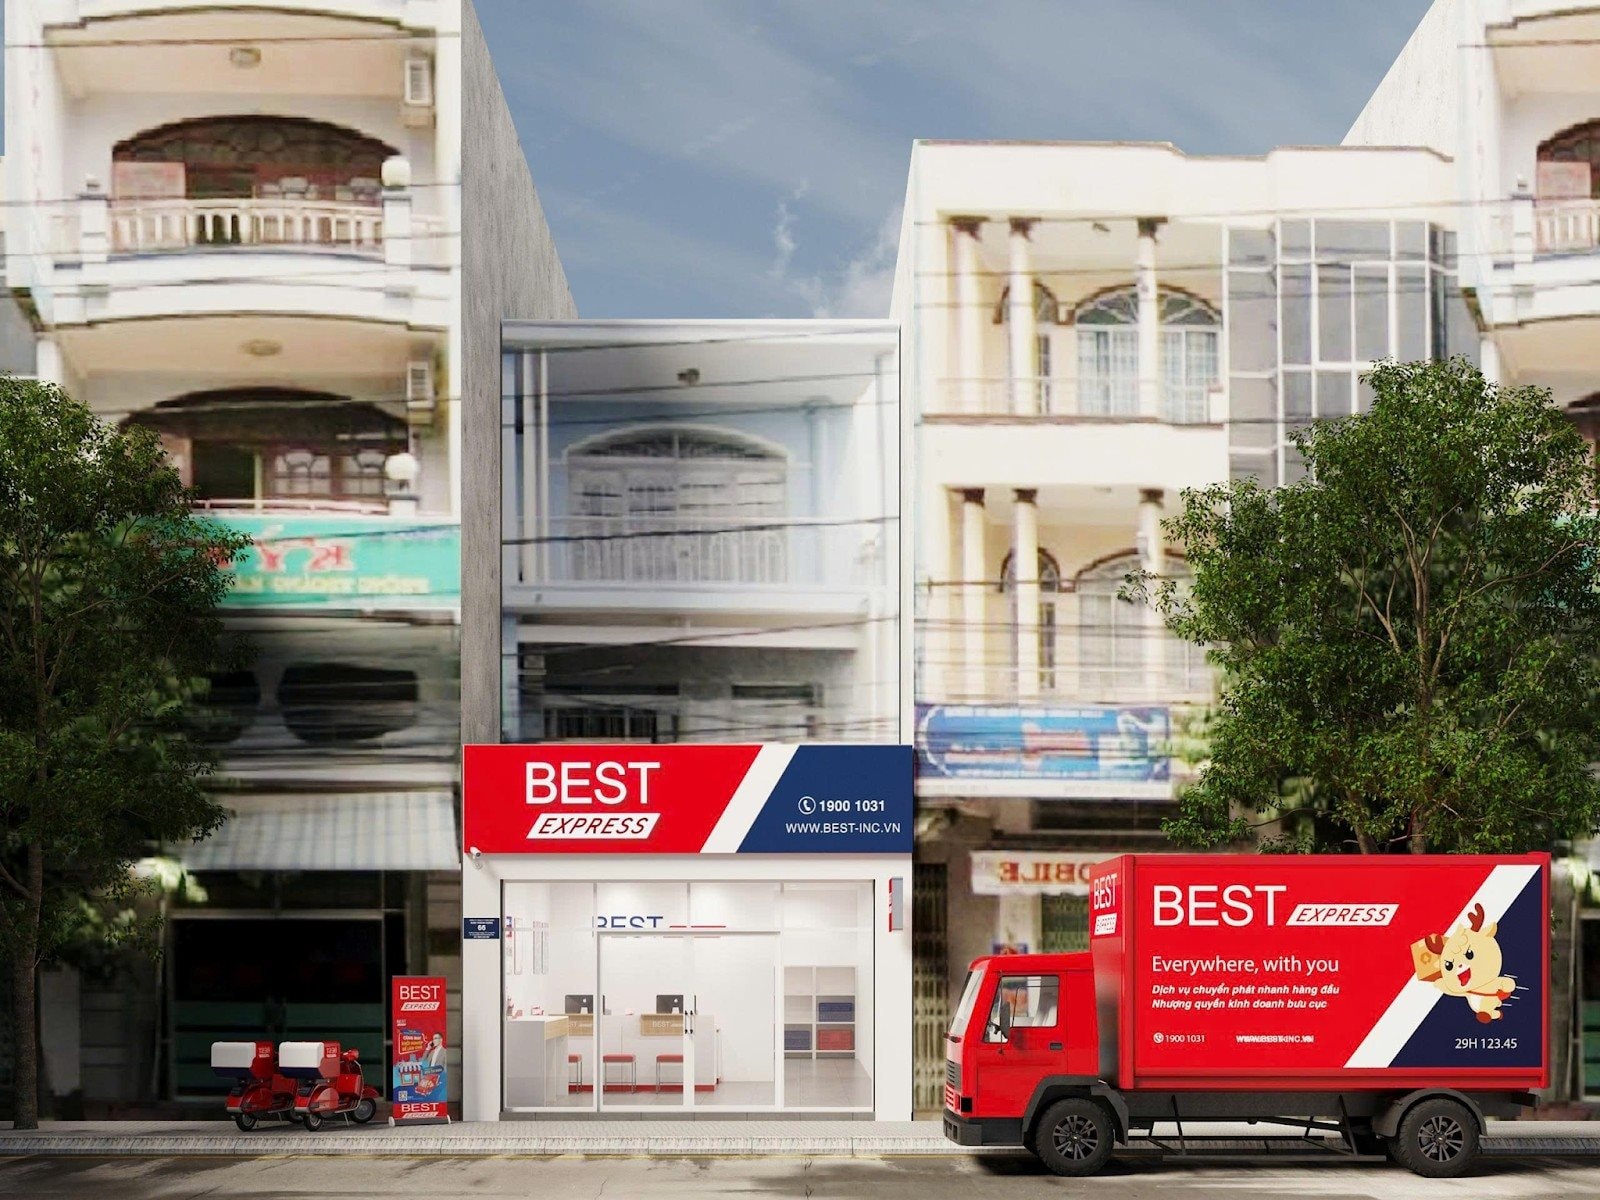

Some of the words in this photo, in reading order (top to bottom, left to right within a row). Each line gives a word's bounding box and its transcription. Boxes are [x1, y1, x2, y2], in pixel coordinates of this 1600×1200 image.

[525, 761, 661, 805] BEST
[819, 799, 851, 812] 1900
[854, 799, 885, 812] 1031
[538, 818, 649, 834] EXPRESS
[785, 822, 901, 834] WWW.BEST-INC.VN
[1093, 873, 1117, 910] BEST
[1153, 884, 1287, 927] BEST
[1296, 907, 1390, 922] EXPRESS
[1152, 955, 1259, 975] Everywhere,
[1263, 955, 1302, 973] with
[1305, 959, 1339, 976] you
[399, 985, 441, 1000] BEST
[1152, 984, 1176, 996] Dịch
[1178, 986, 1191, 996] vụ
[1231, 984, 1256, 997] phát
[1258, 984, 1290, 995] nhanh
[403, 1002, 438, 1010] EXPRESS
[1228, 999, 1251, 1009] kinh
[1253, 999, 1285, 1009] doanh
[1165, 1034, 1185, 1043] 1900
[1186, 1034, 1205, 1043] 1031
[1454, 1037, 1478, 1049] 29H
[1480, 1038, 1518, 1049] 123.45
[401, 1102, 439, 1112] BEST
